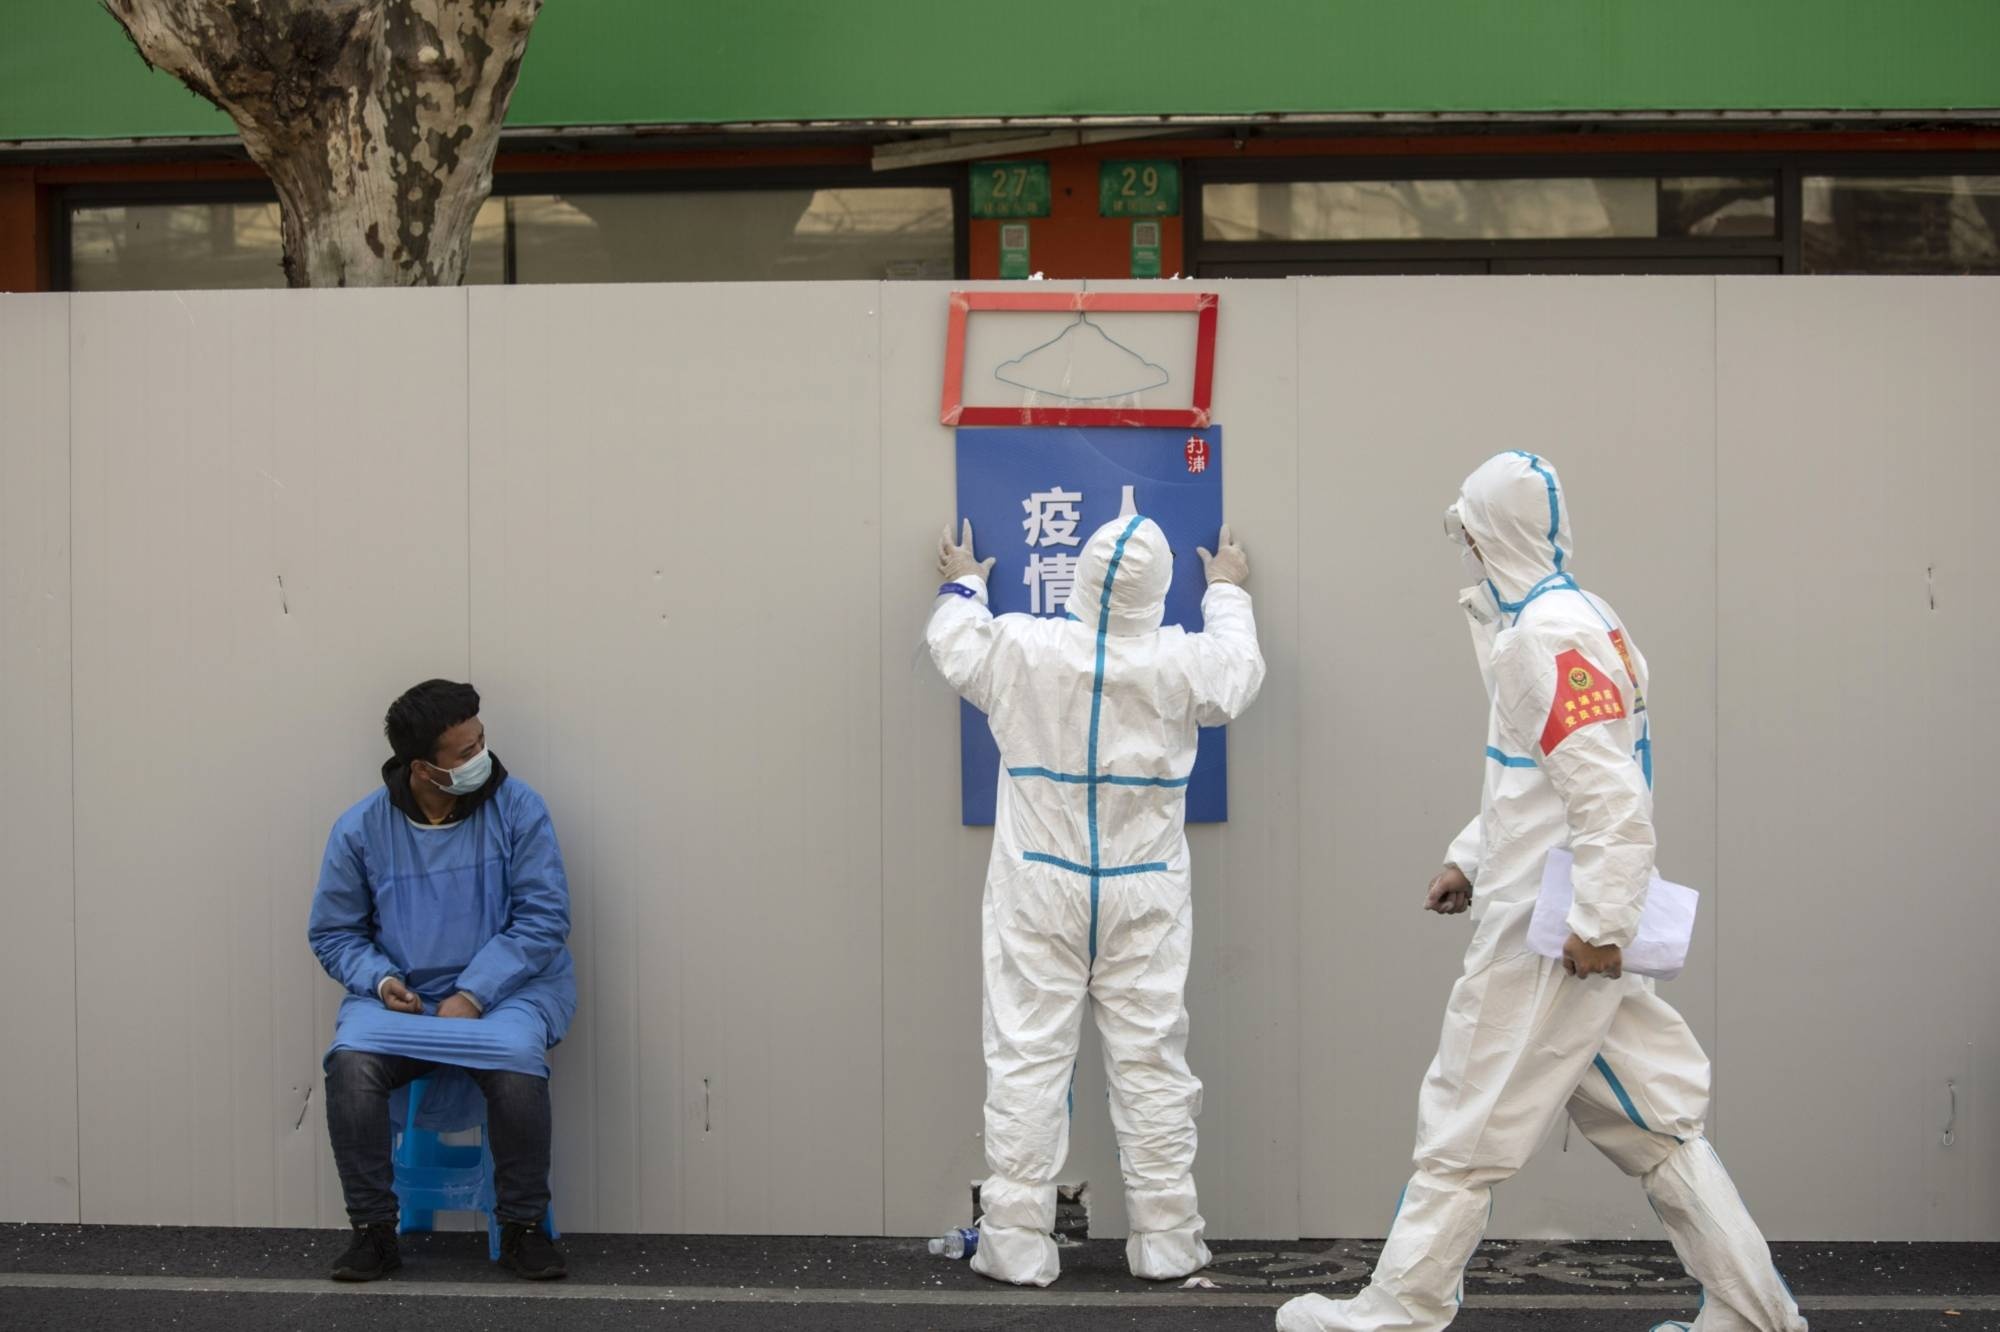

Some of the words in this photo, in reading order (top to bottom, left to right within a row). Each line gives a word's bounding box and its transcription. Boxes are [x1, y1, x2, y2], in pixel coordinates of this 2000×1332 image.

[992, 168, 1027, 197] 27
[1121, 166, 1158, 197] 29
[1187, 436, 1206, 473] 打浦
[1022, 486, 1082, 614] 疫情
